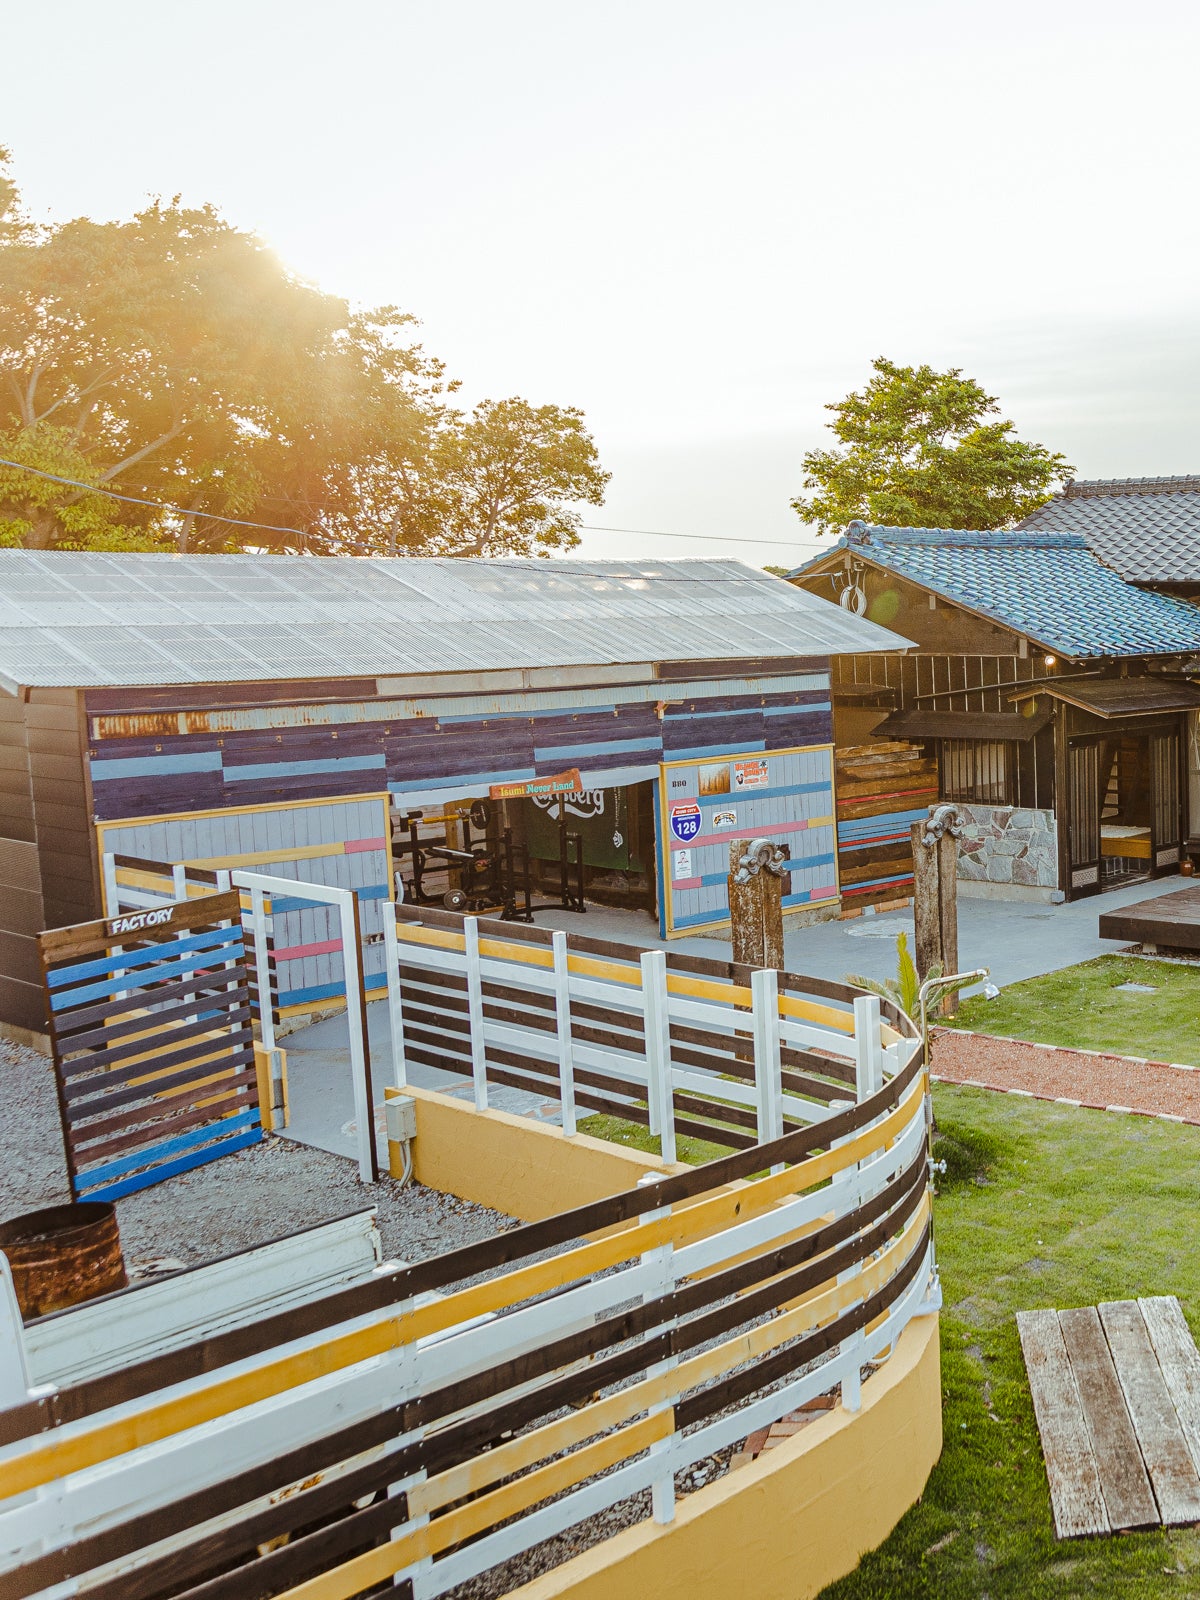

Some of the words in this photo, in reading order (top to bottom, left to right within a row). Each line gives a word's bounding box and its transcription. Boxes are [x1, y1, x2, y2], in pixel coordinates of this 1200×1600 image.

[500, 786, 525, 797] Isumi
[526, 784, 551, 794] Never
[553, 780, 574, 791] Land
[672, 780, 687, 788] BBQ
[677, 821, 697, 835] 128
[111, 907, 174, 935] FACTORY
